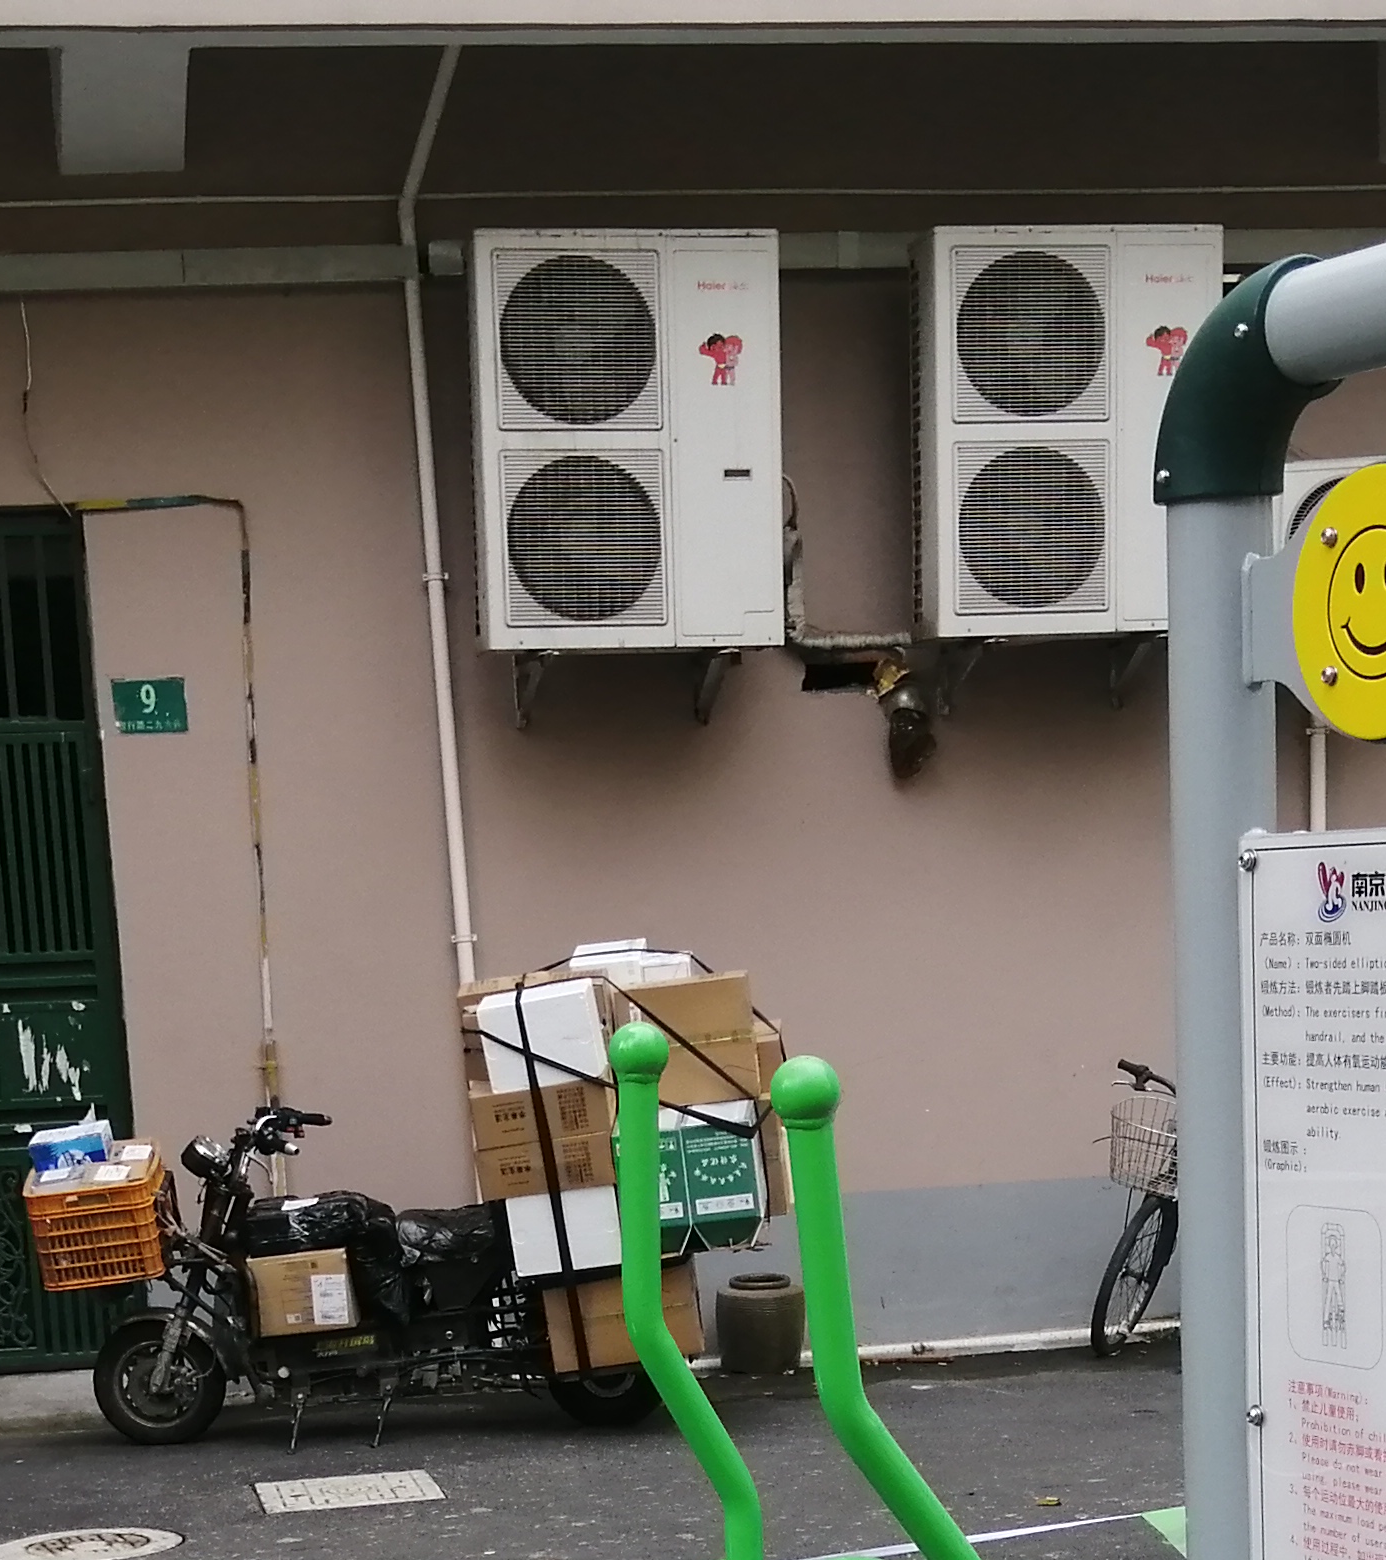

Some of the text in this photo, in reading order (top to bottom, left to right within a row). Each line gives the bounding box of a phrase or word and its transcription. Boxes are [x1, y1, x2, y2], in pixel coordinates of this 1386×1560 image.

[140, 683, 156, 714] 9
[1305, 957, 1347, 969] Two-sided
[1305, 1005, 1320, 1018] The
[1323, 1006, 1370, 1019] exercisers
[1351, 1032, 1366, 1043] and
[1370, 1032, 1385, 1044] the
[1306, 1078, 1353, 1092] Strengthen
[1356, 1080, 1380, 1093] human
[1306, 1102, 1339, 1115] aerobic
[1343, 1104, 1380, 1118] exercise
[1301, 1417, 1351, 1436] Prohibition
[1355, 1428, 1364, 1439] of
[1302, 1451, 1329, 1467] Please
[1333, 1459, 1342, 1470] do
[1346, 1464, 1360, 1474] not
[1364, 1468, 1382, 1477] wear
[1333, 1477, 1360, 1491] please
[1364, 1485, 1382, 1496] wear
[1303, 1503, 1316, 1516] The
[1320, 1510, 1353, 1524] maximum
[1357, 1515, 1375, 1530] load
[1303, 1521, 1316, 1533] the
[1320, 1527, 1347, 1540] number
[1351, 1532, 1360, 1543] of
